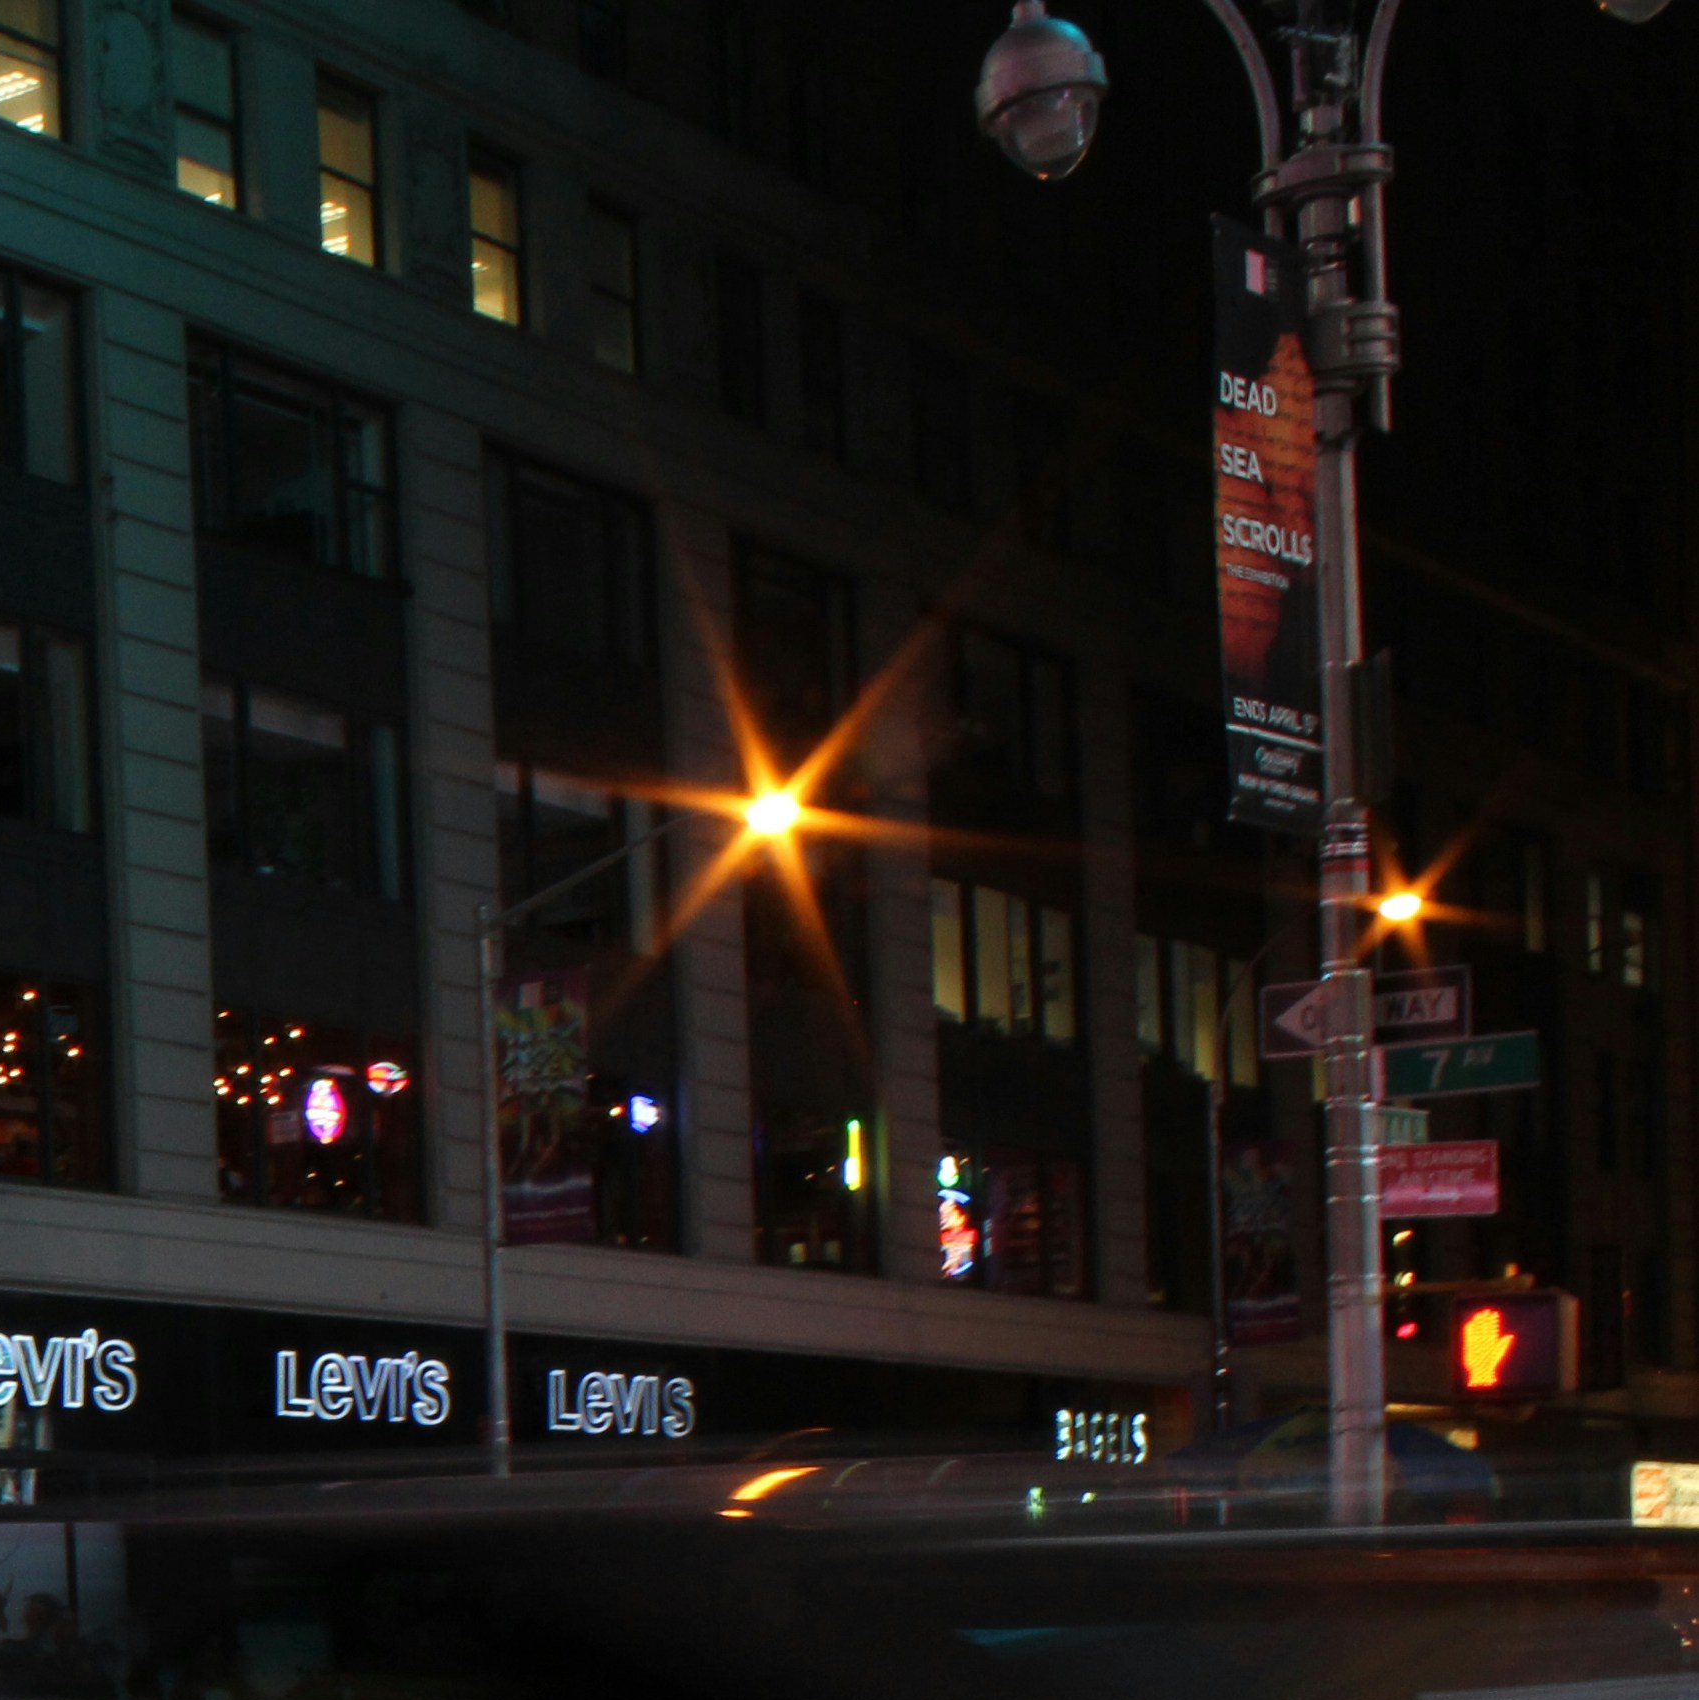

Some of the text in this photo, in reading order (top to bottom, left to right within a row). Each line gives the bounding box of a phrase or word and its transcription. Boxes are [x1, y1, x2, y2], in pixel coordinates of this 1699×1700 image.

[1219, 370, 1278, 417] DEAD
[1219, 443, 1264, 484] SEA
[1221, 513, 1313, 567] SCROLLS
[1233, 697, 1266, 723] ENDS
[1384, 992, 1445, 1021] WAY
[1420, 1049, 1452, 1090] 7
[1054, 1407, 1148, 1465] BAGELS
